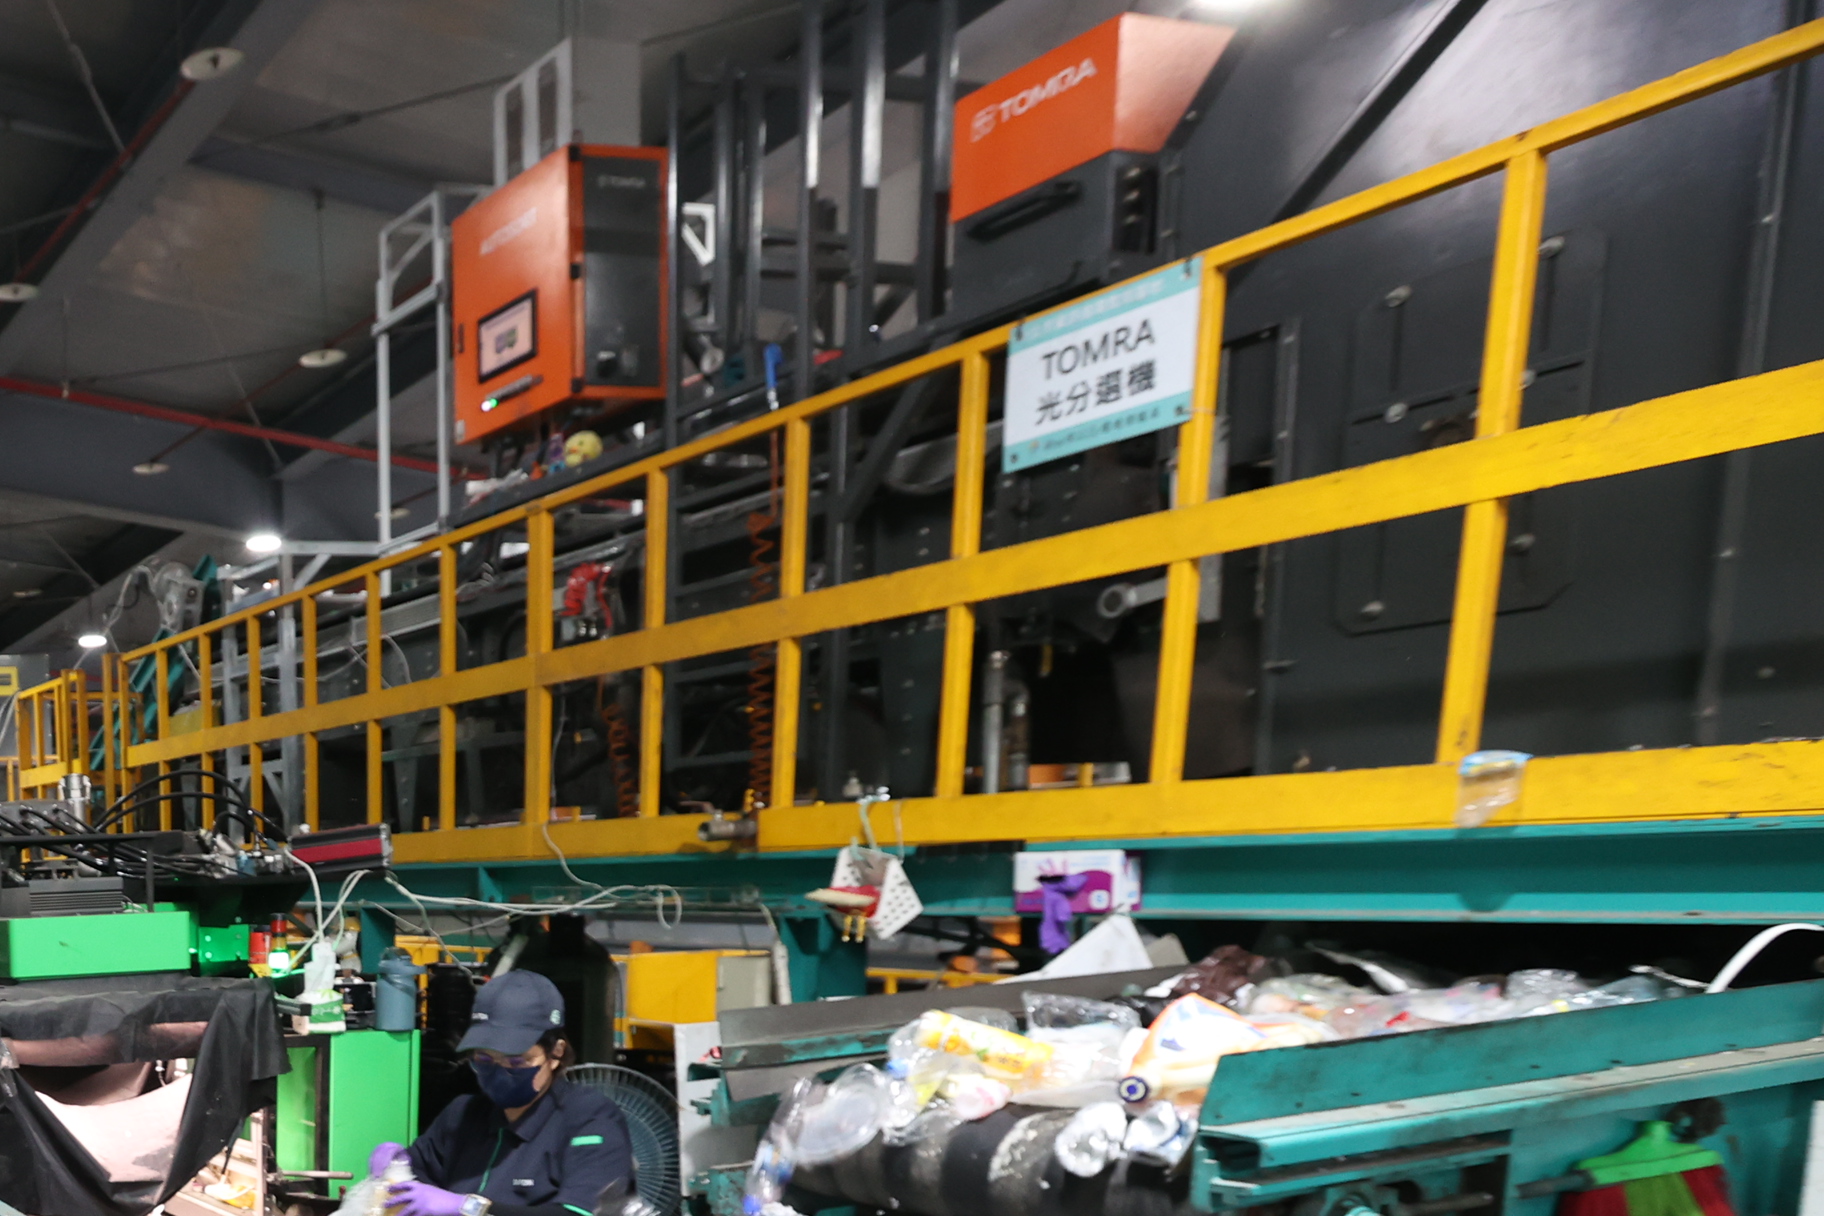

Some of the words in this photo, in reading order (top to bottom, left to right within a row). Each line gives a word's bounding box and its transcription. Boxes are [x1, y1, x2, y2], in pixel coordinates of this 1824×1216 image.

[1041, 318, 1156, 381] TOMRA
[1034, 358, 1156, 427] 光分選機
